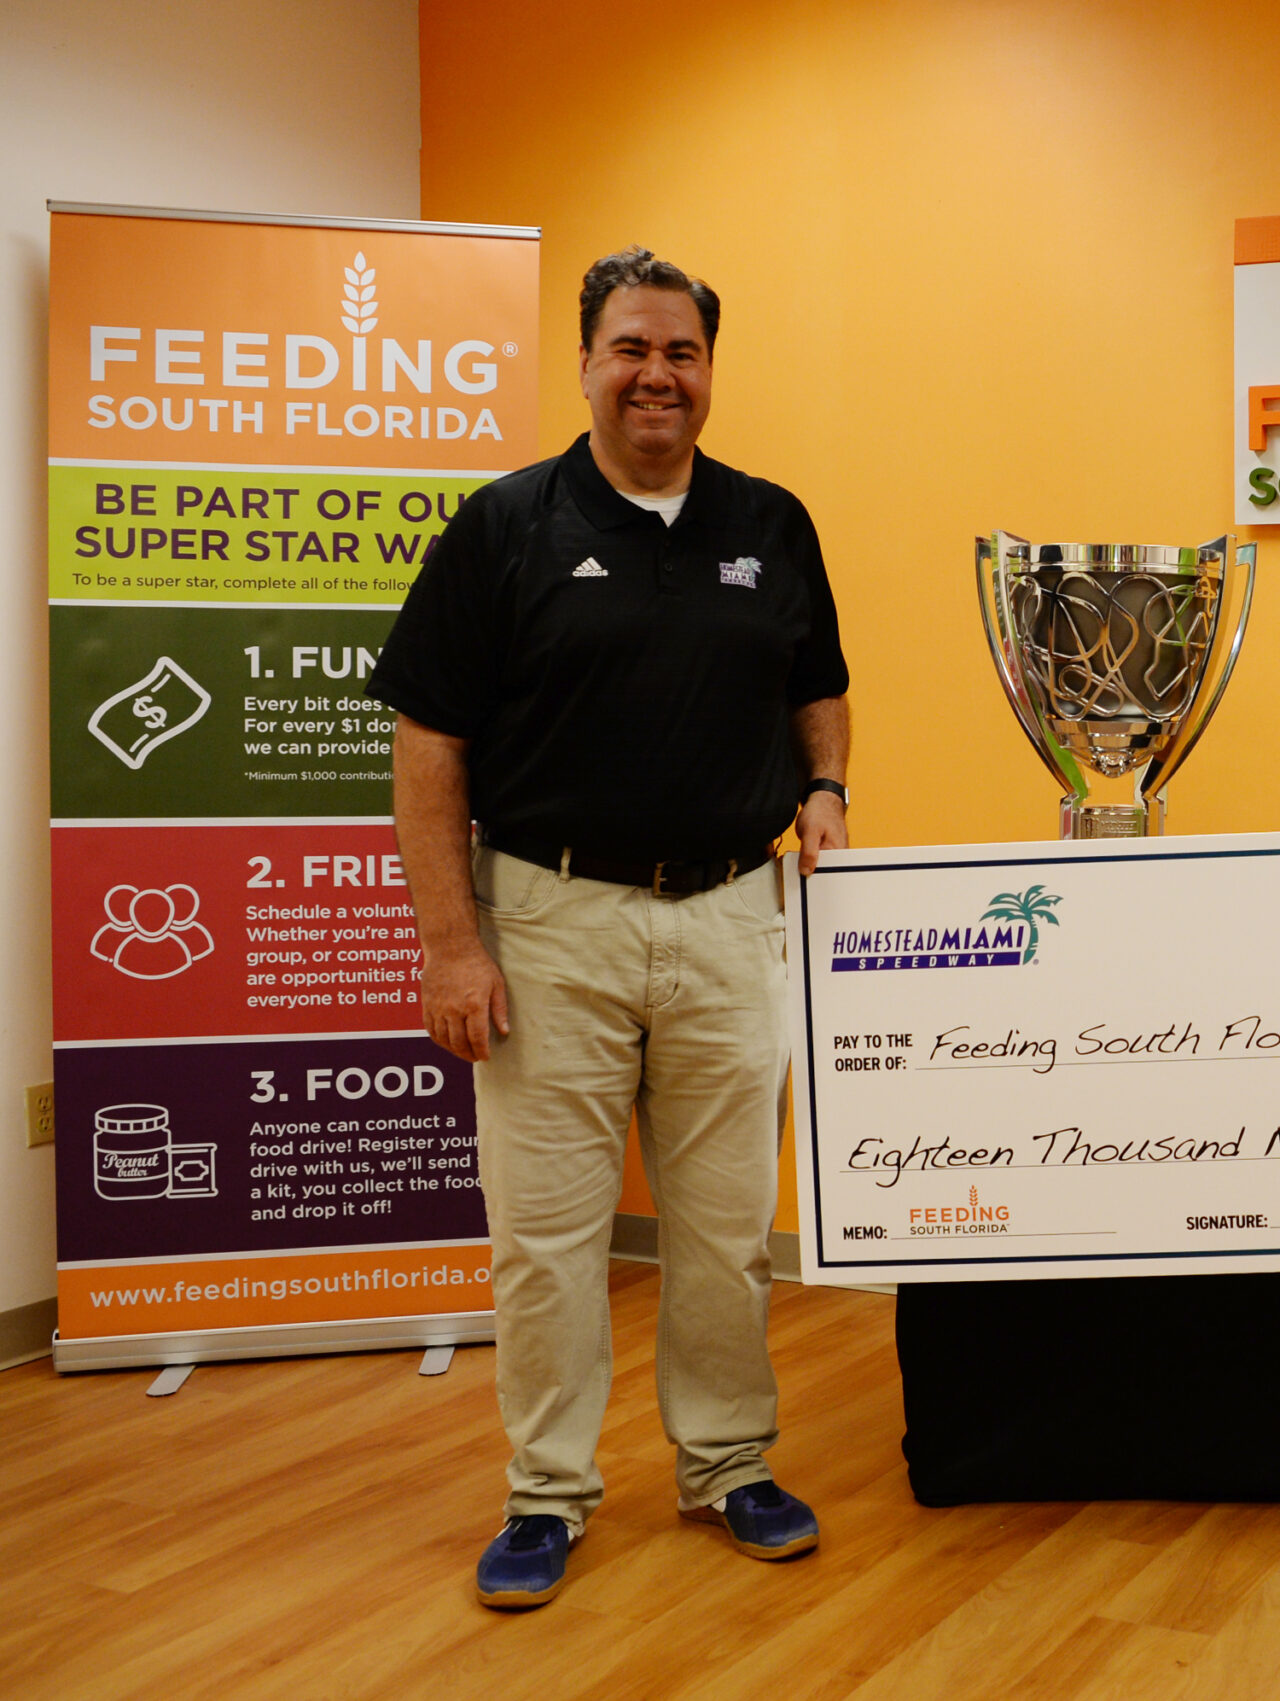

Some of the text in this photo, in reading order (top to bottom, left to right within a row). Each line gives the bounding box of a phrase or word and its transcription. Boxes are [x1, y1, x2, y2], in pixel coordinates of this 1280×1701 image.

[88, 395, 502, 440] SOUTH FLORIDA
[96, 484, 156, 516] BE
[177, 486, 299, 520] PART
[317, 490, 382, 521] OF
[75, 527, 230, 561] SUPER
[245, 530, 360, 563] STAR
[73, 573, 414, 593] To be a super star, complete all of the follo
[244, 647, 273, 678] 1.
[244, 697, 298, 713] Every
[305, 697, 329, 712] bit
[336, 697, 381, 712] does
[244, 719, 277, 733] For
[283, 721, 336, 736] every
[341, 719, 360, 735] $1
[244, 741, 391, 757] we can provide
[301, 771, 336, 781] $1,000
[246, 855, 408, 888] 2. FRIE
[246, 905, 331, 920] Schedule
[337, 908, 347, 919] a
[247, 925, 415, 943] Whether you're an
[247, 947, 421, 965] group, or company
[859, 954, 994, 969] SPEEDWAY
[247, 971, 275, 985] are
[281, 967, 405, 986] opportunities
[247, 989, 417, 1008] everyone to lend a
[834, 1034, 912, 1050] PAY TO THE
[929, 1025, 1057, 1073] Feeding
[1076, 1021, 1200, 1055] South
[834, 1056, 907, 1072] ORDER OF:
[250, 1064, 444, 1102] 3. FOOD
[250, 1115, 456, 1138] Anyone can conduct a
[250, 1141, 294, 1156] food
[300, 1139, 352, 1154] drive!
[359, 1136, 434, 1152] Register
[847, 1135, 1013, 1187] Eighteen
[1033, 1127, 1245, 1165] Thousand
[250, 1156, 470, 1178] drive with us, we'll send
[251, 1185, 260, 1198] a
[267, 1183, 296, 1199] kit,
[302, 1182, 336, 1197] you
[342, 1177, 404, 1194] collect
[409, 1176, 438, 1189] the
[251, 1199, 391, 1221] and drop it off!
[910, 1206, 1009, 1223] FEEDING
[910, 1225, 951, 1234] SOUTH
[1187, 1214, 1267, 1230] SIGNATURE:
[843, 1226, 887, 1240] MEMO:
[90, 1267, 491, 1307] www.feedingsouthflorida.o
